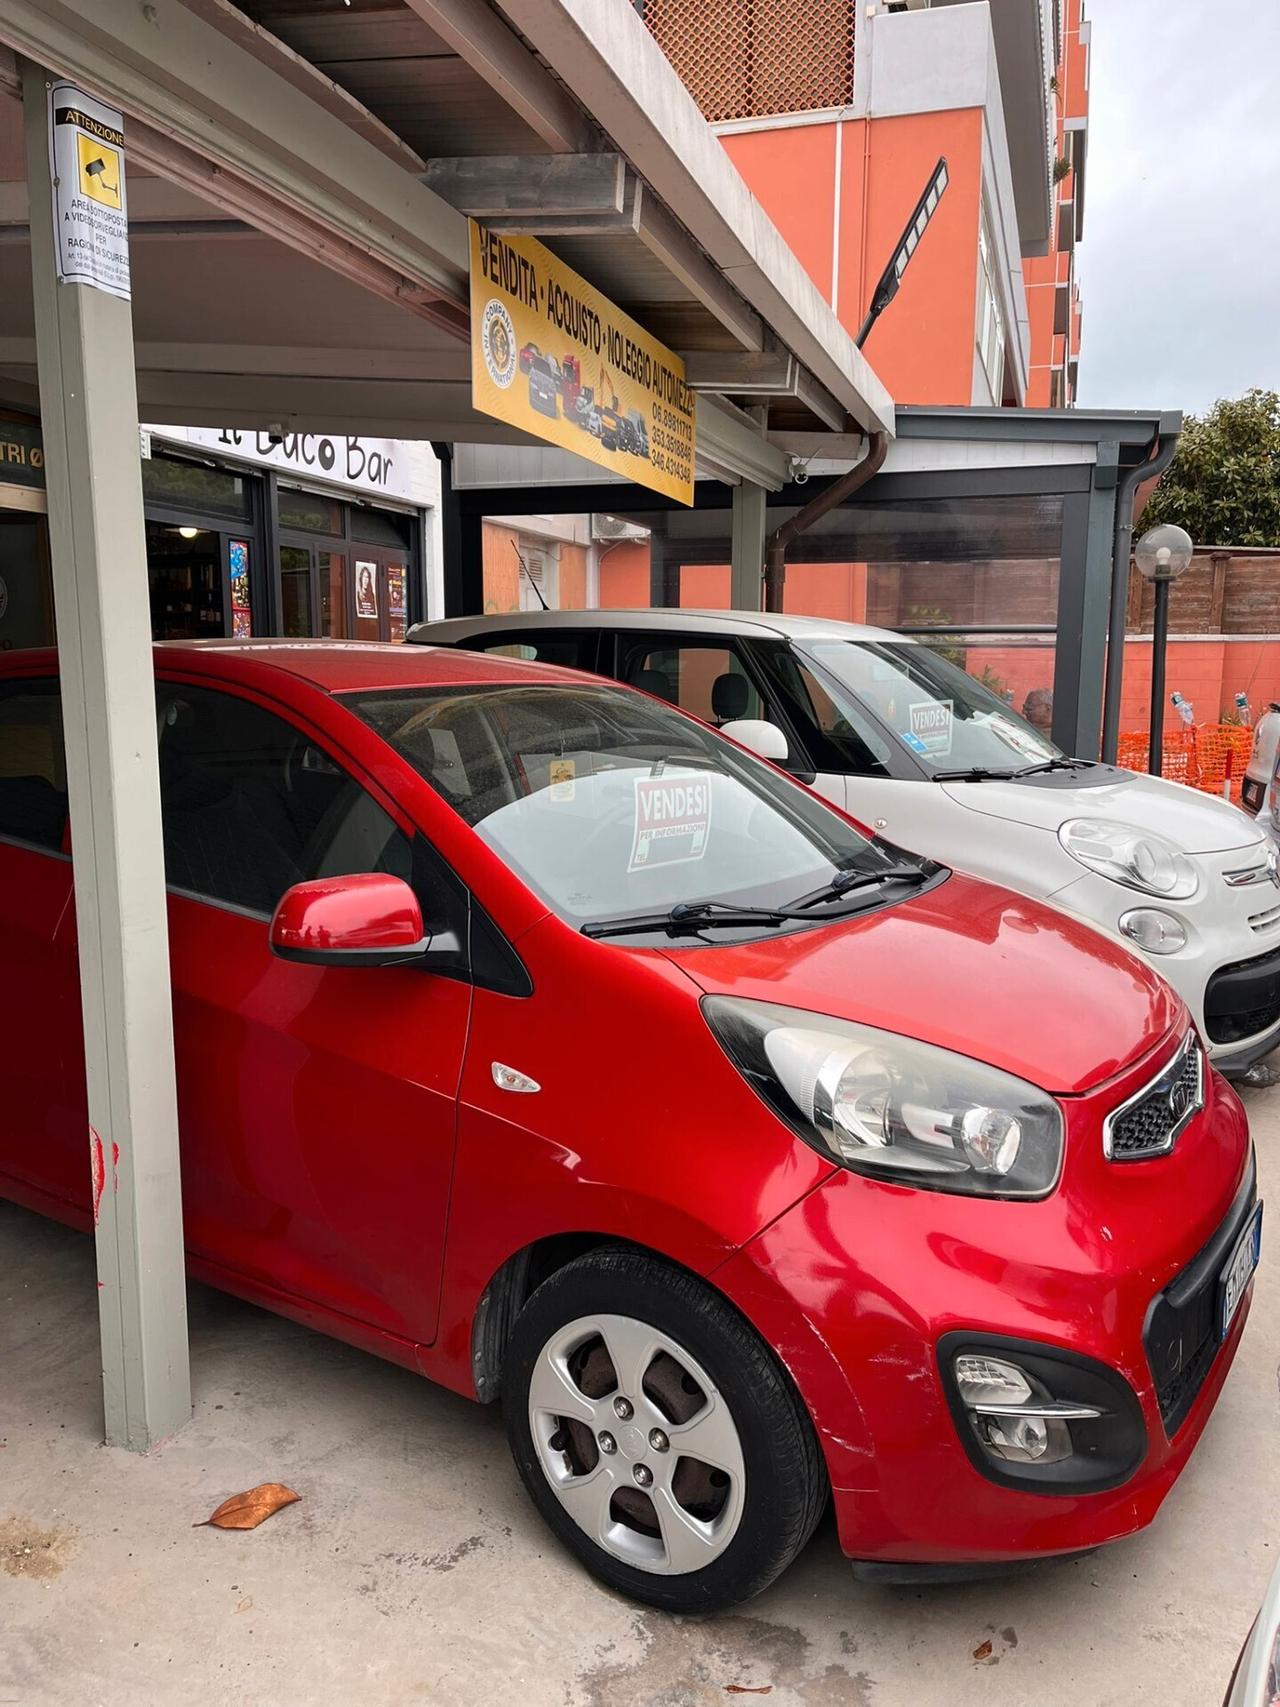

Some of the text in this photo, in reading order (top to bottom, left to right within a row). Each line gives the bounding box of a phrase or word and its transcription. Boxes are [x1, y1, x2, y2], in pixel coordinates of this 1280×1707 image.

[66, 110, 124, 147] ATTENZIONE
[64, 212, 70, 222] A
[95, 233, 107, 245] PER
[478, 223, 539, 312] VENDITA
[547, 279, 602, 355] ACQUISTO
[608, 325, 651, 389] NOLEGGIO
[486, 303, 512, 333] COMPANY
[345, 434, 393, 486] Bar
[913, 708, 950, 730] VENDESI
[640, 784, 707, 822] VENDESI
